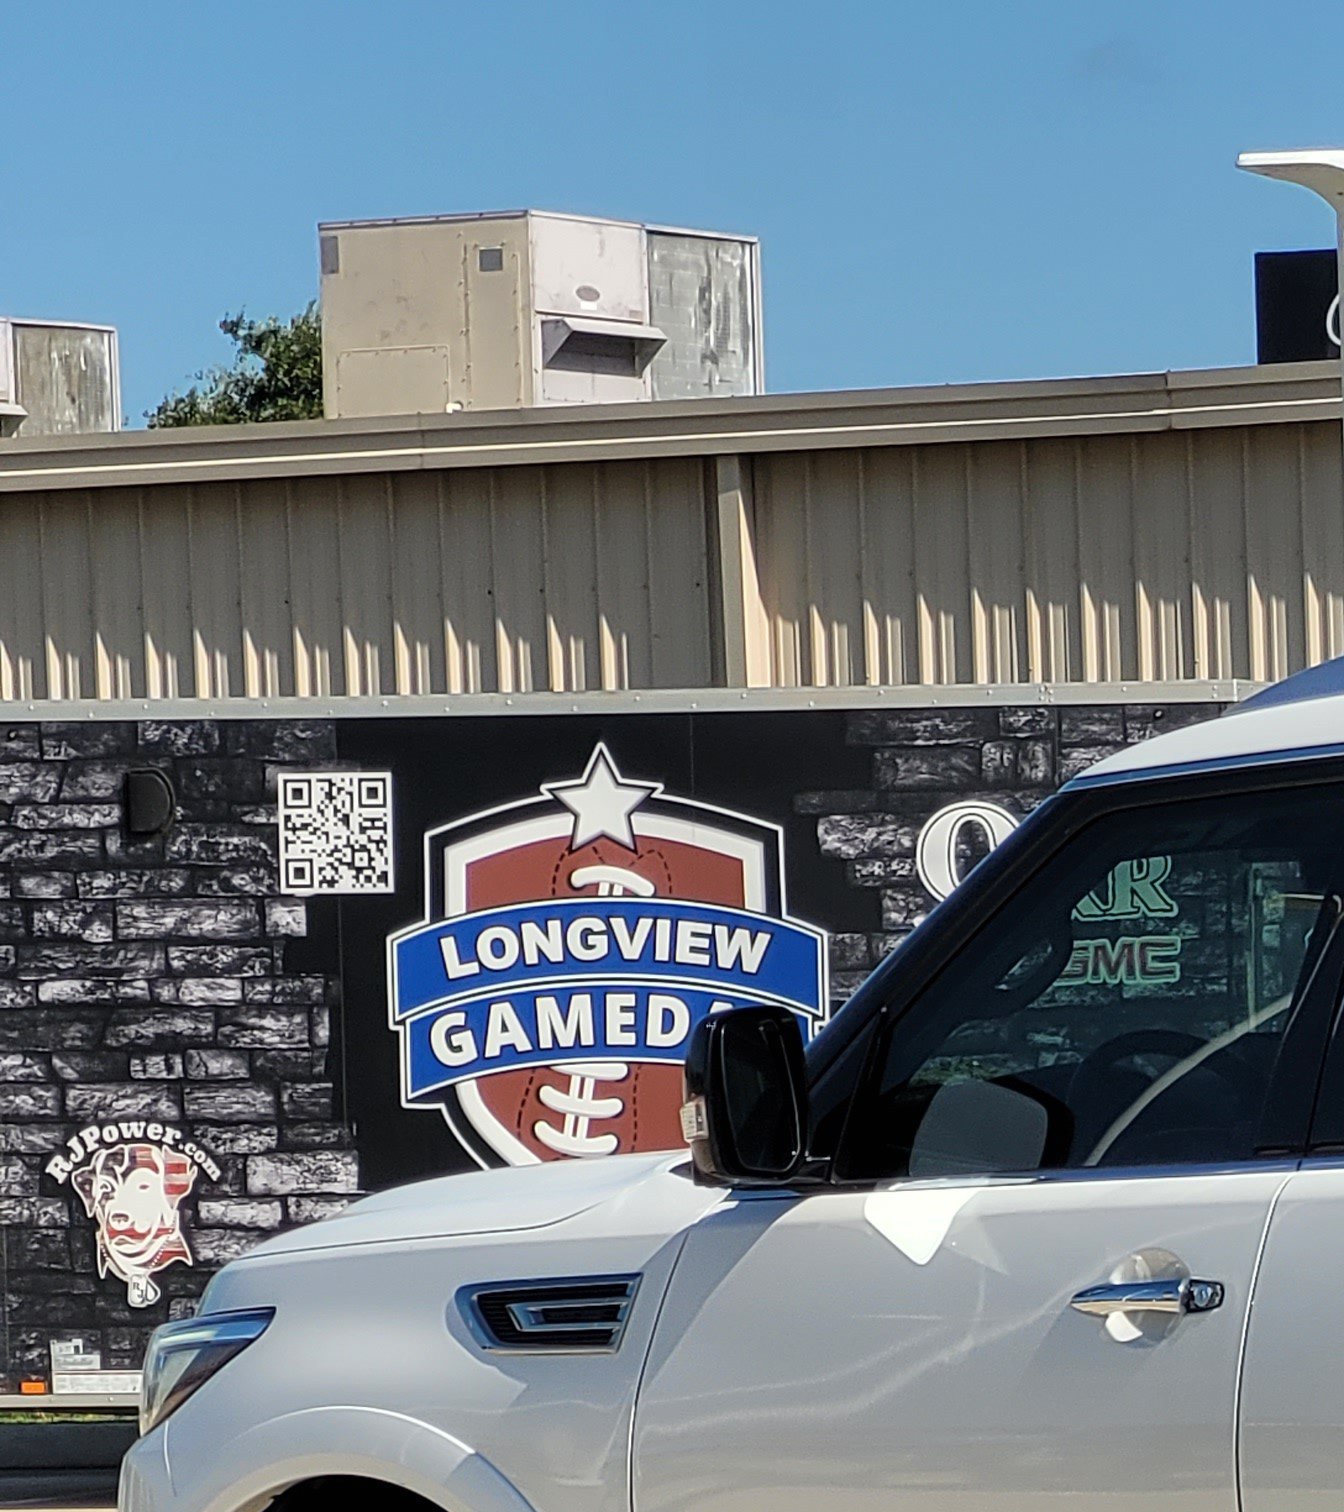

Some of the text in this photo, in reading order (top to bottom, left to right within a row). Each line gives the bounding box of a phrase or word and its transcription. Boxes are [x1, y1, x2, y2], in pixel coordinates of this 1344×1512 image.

[439, 916, 772, 980] LONGVIEW
[429, 993, 736, 1068] GAMED
[45, 1121, 222, 1184] RJPower.com
